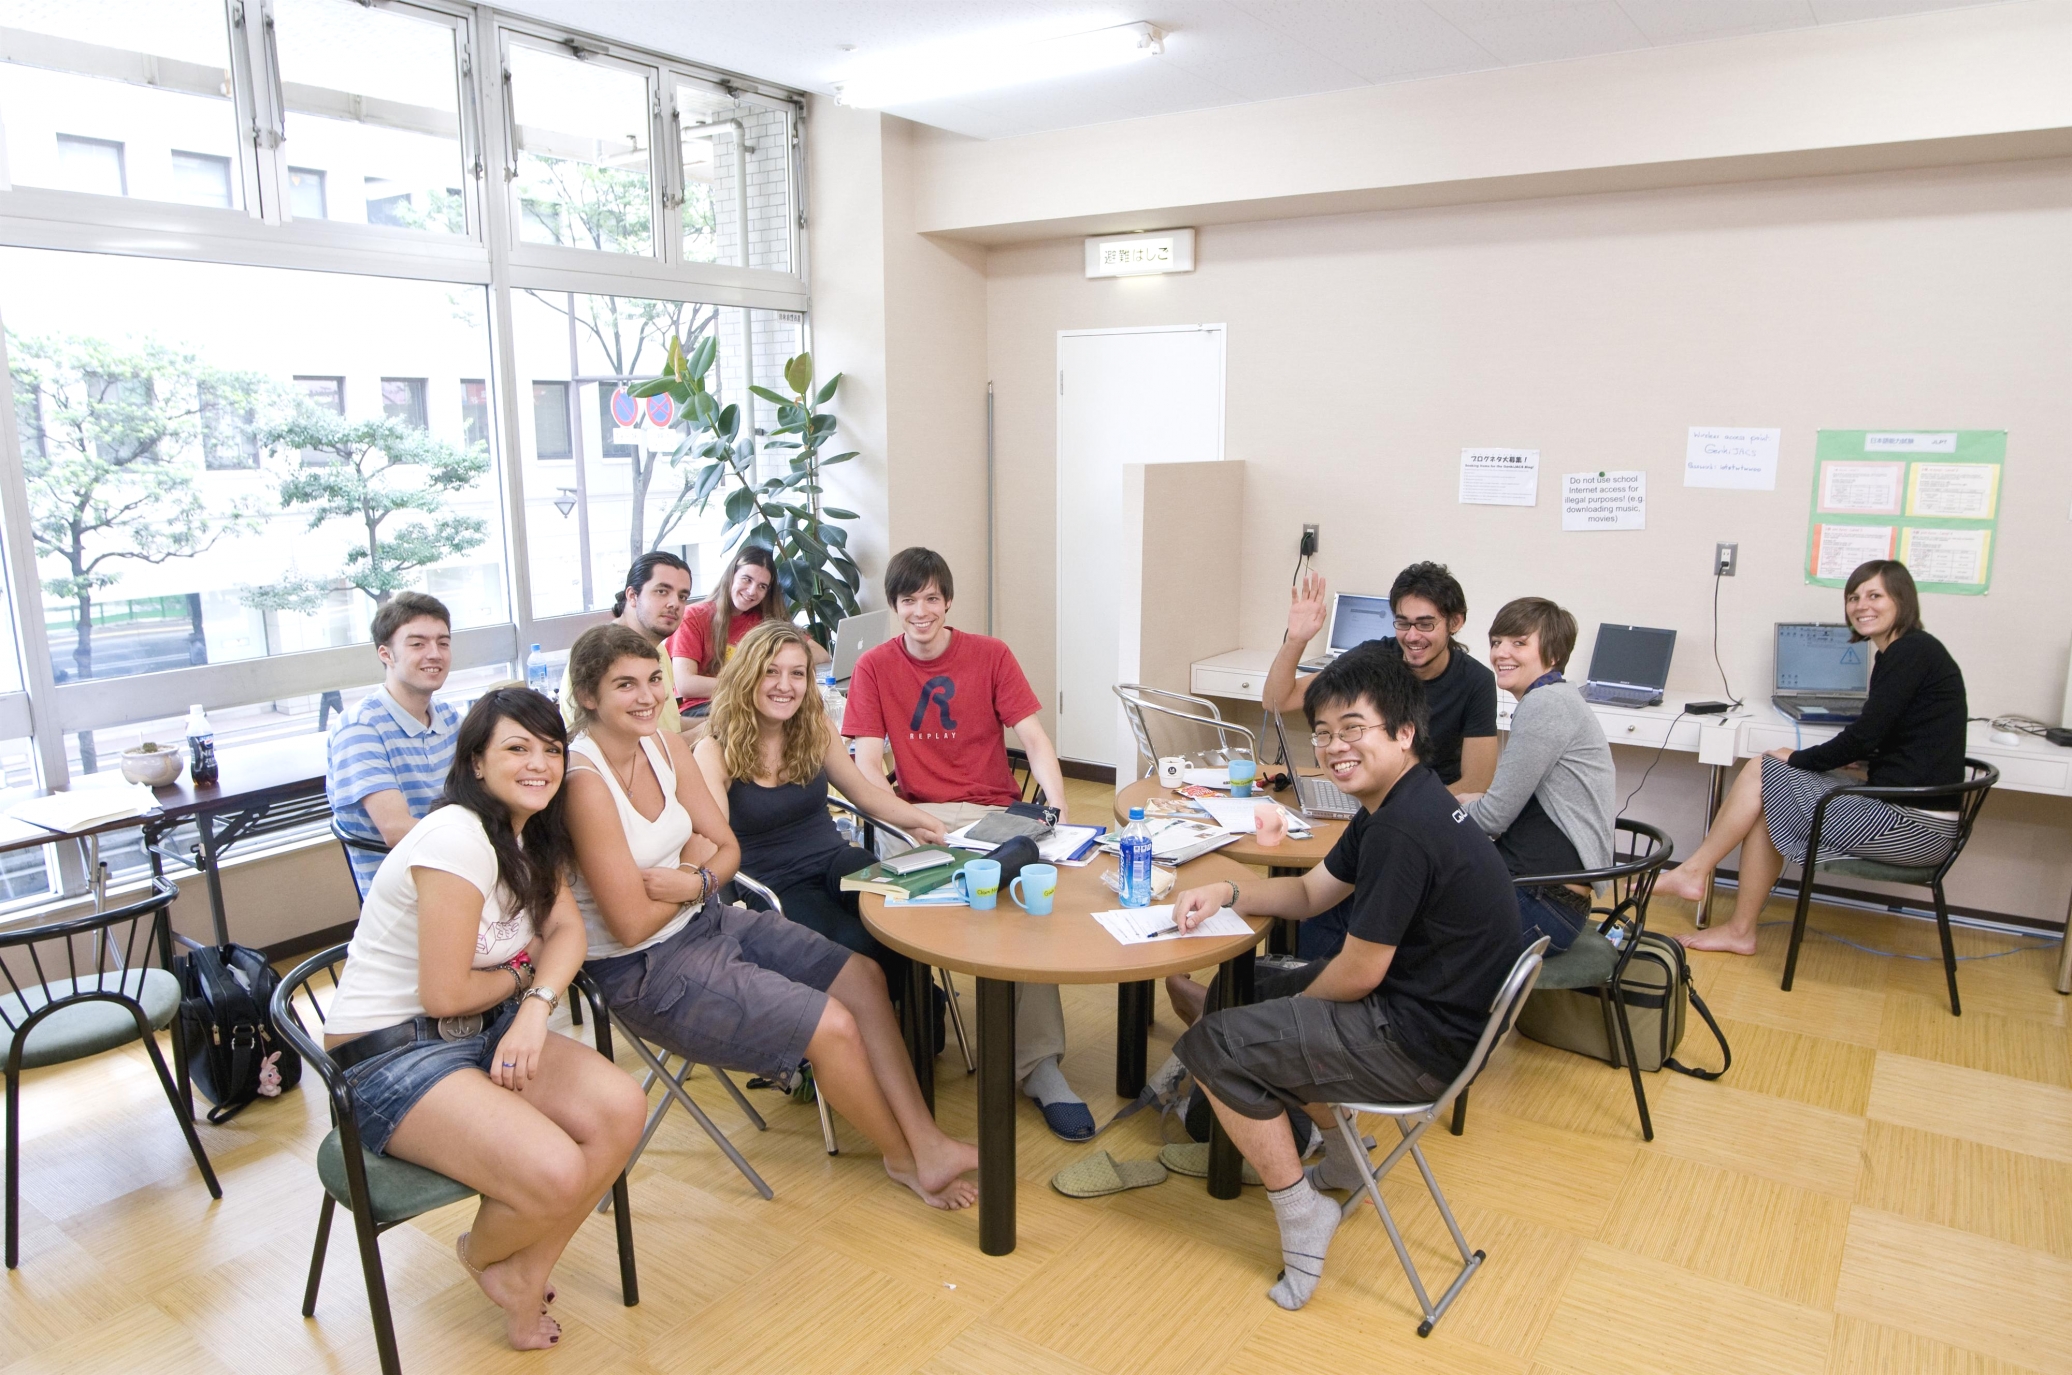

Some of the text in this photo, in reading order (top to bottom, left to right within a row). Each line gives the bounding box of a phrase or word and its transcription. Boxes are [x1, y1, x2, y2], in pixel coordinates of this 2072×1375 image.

[1104, 247, 1169, 264] 避難はしご
[1564, 496, 1586, 505] illegal
[1588, 495, 1625, 504] purposes!
[1566, 505, 1641, 514] downloading music,
[1587, 515, 1618, 523] movies)
[909, 732, 957, 740] REPLAY
